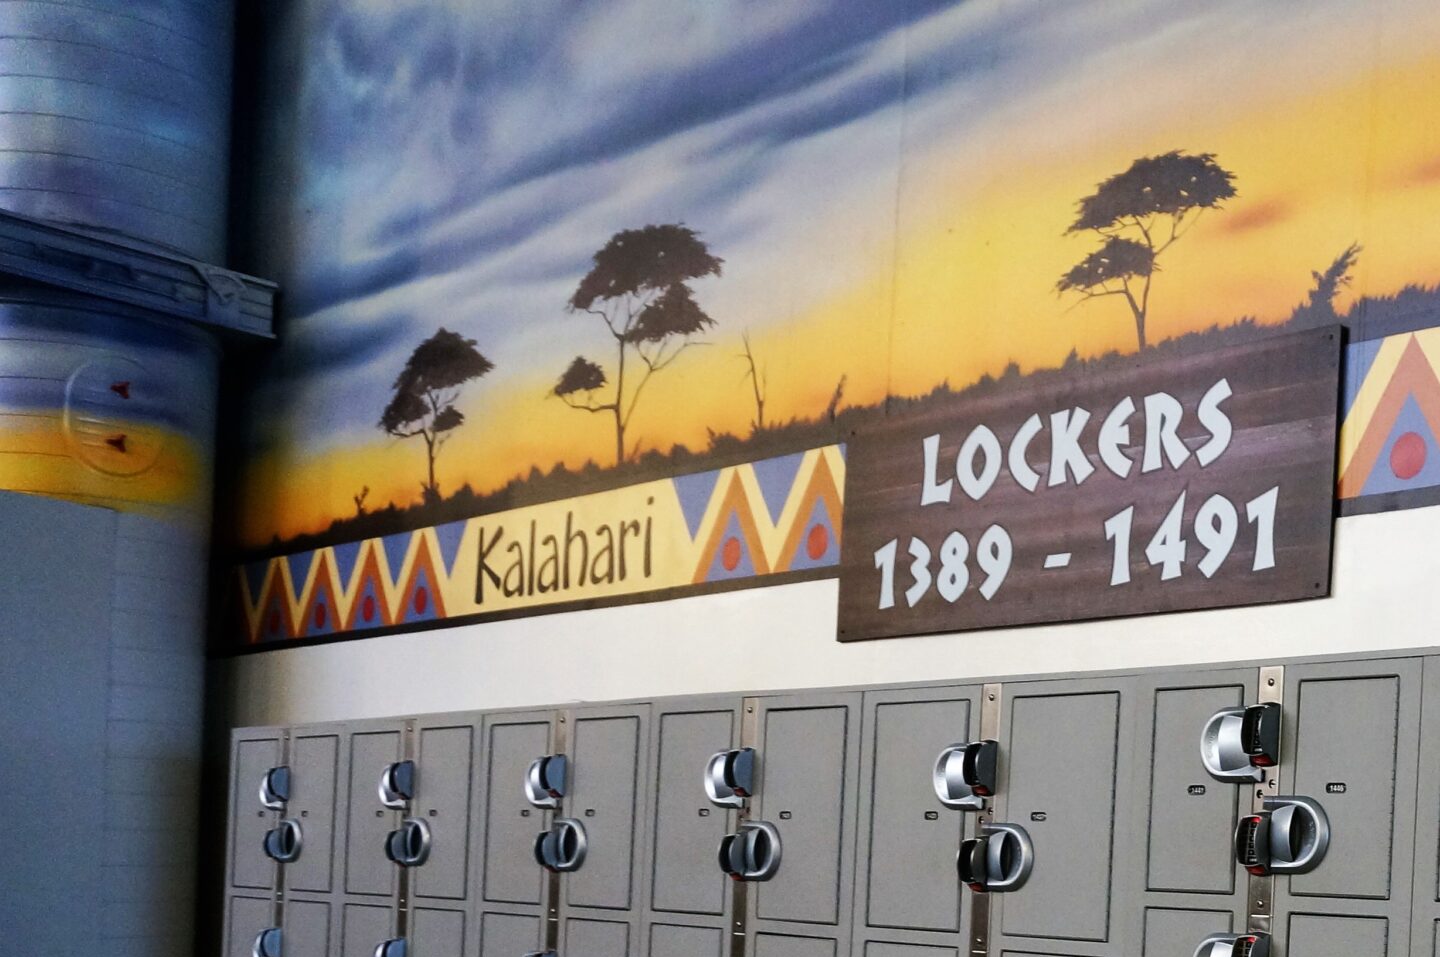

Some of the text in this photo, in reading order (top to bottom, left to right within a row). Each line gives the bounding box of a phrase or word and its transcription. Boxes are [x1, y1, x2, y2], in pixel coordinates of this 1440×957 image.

[920, 378, 1233, 506] LOCKERS
[474, 496, 655, 605] Kalahari
[874, 524, 1013, 610] 1389
[1104, 485, 1279, 587] 1491
